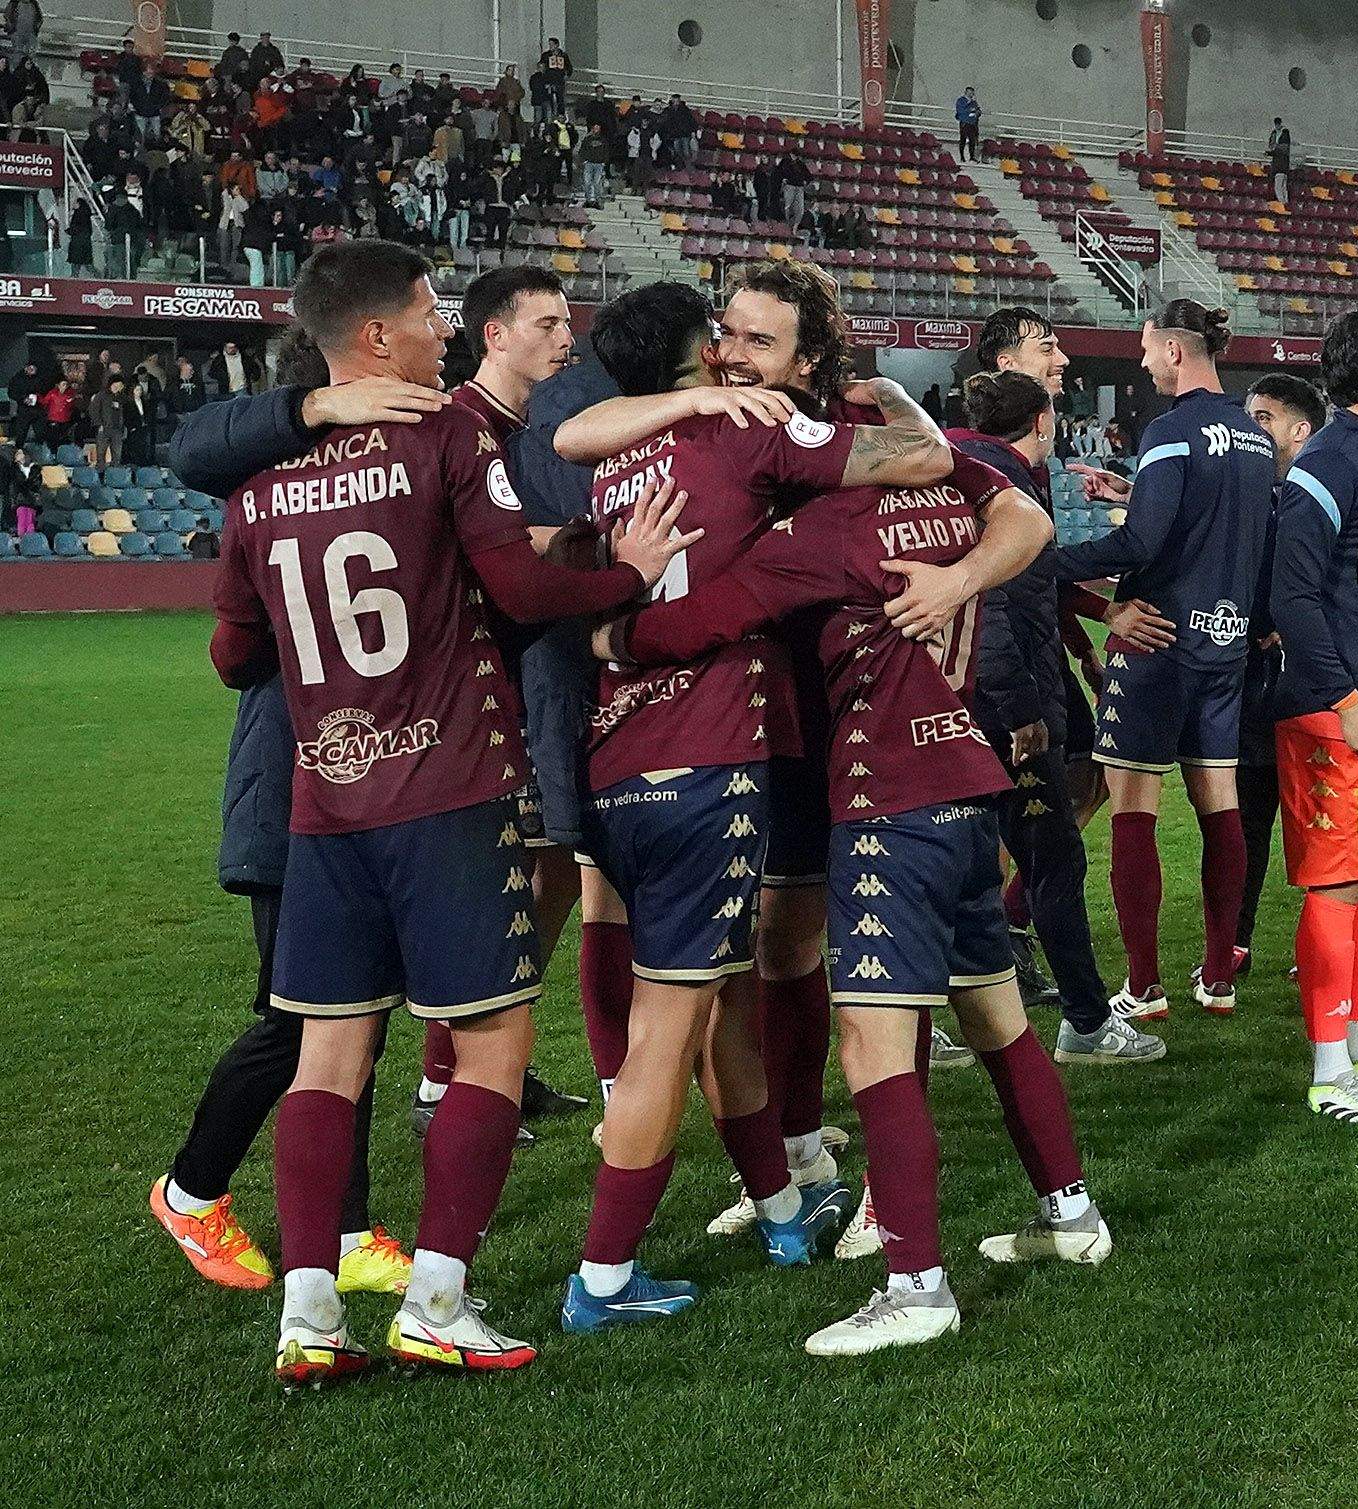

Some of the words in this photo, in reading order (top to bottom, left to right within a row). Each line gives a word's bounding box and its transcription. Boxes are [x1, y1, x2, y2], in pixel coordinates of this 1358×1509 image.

[0, 153, 52, 165] utación
[0, 165, 53, 177] tevedra
[174, 286, 235, 299] CONSERVAS
[145, 295, 262, 320] PESCAMAR
[242, 489, 267, 524] B.
[271, 462, 412, 518] ABELENDA
[876, 518, 951, 557] YELKO
[267, 530, 410, 686] 16
[317, 707, 376, 732] CONSERVAS
[296, 718, 442, 770] SCAMAR
